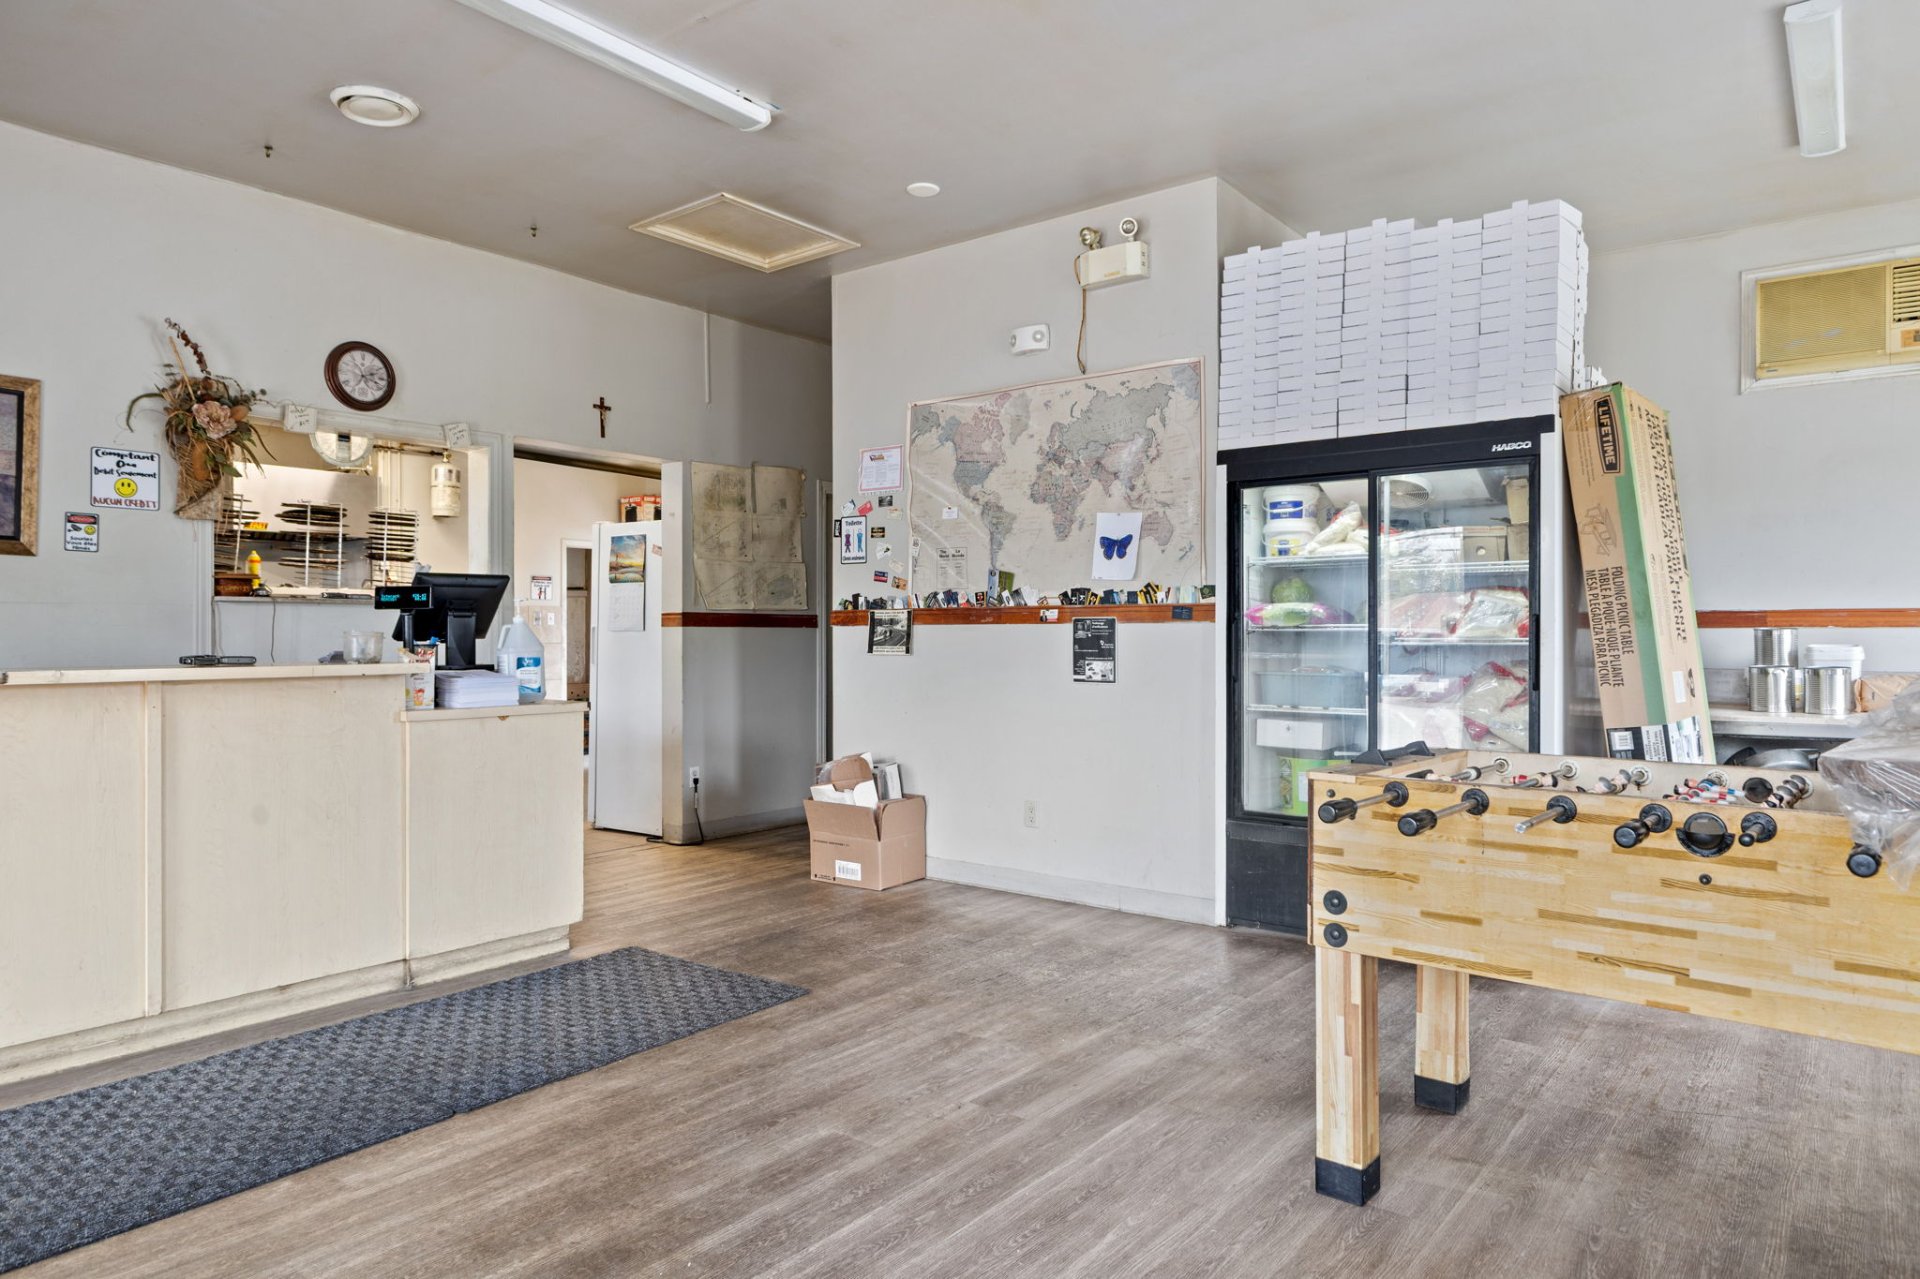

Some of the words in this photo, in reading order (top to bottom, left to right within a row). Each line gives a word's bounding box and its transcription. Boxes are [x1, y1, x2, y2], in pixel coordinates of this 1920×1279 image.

[1491, 441, 1532, 452] HABCO
[1599, 405, 1617, 465] LIFETIME
[95, 449, 155, 461] Comptant
[93, 496, 123, 506] AUCUN
[124, 499, 157, 508] CREDIT
[1585, 569, 1597, 591] MESA
[1598, 567, 1611, 592] TABLE
[1611, 566, 1627, 601] FOLDING
[1588, 592, 1604, 636] PLEGADIZA
[1603, 601, 1620, 653] PIQUE-NIQUE
[1616, 602, 1631, 629] PICNIC
[1594, 637, 1607, 659] PARA
[1620, 629, 1634, 655] TABLE
[1597, 660, 1611, 687] PICNIC
[1609, 654, 1624, 687] PLIANTE
